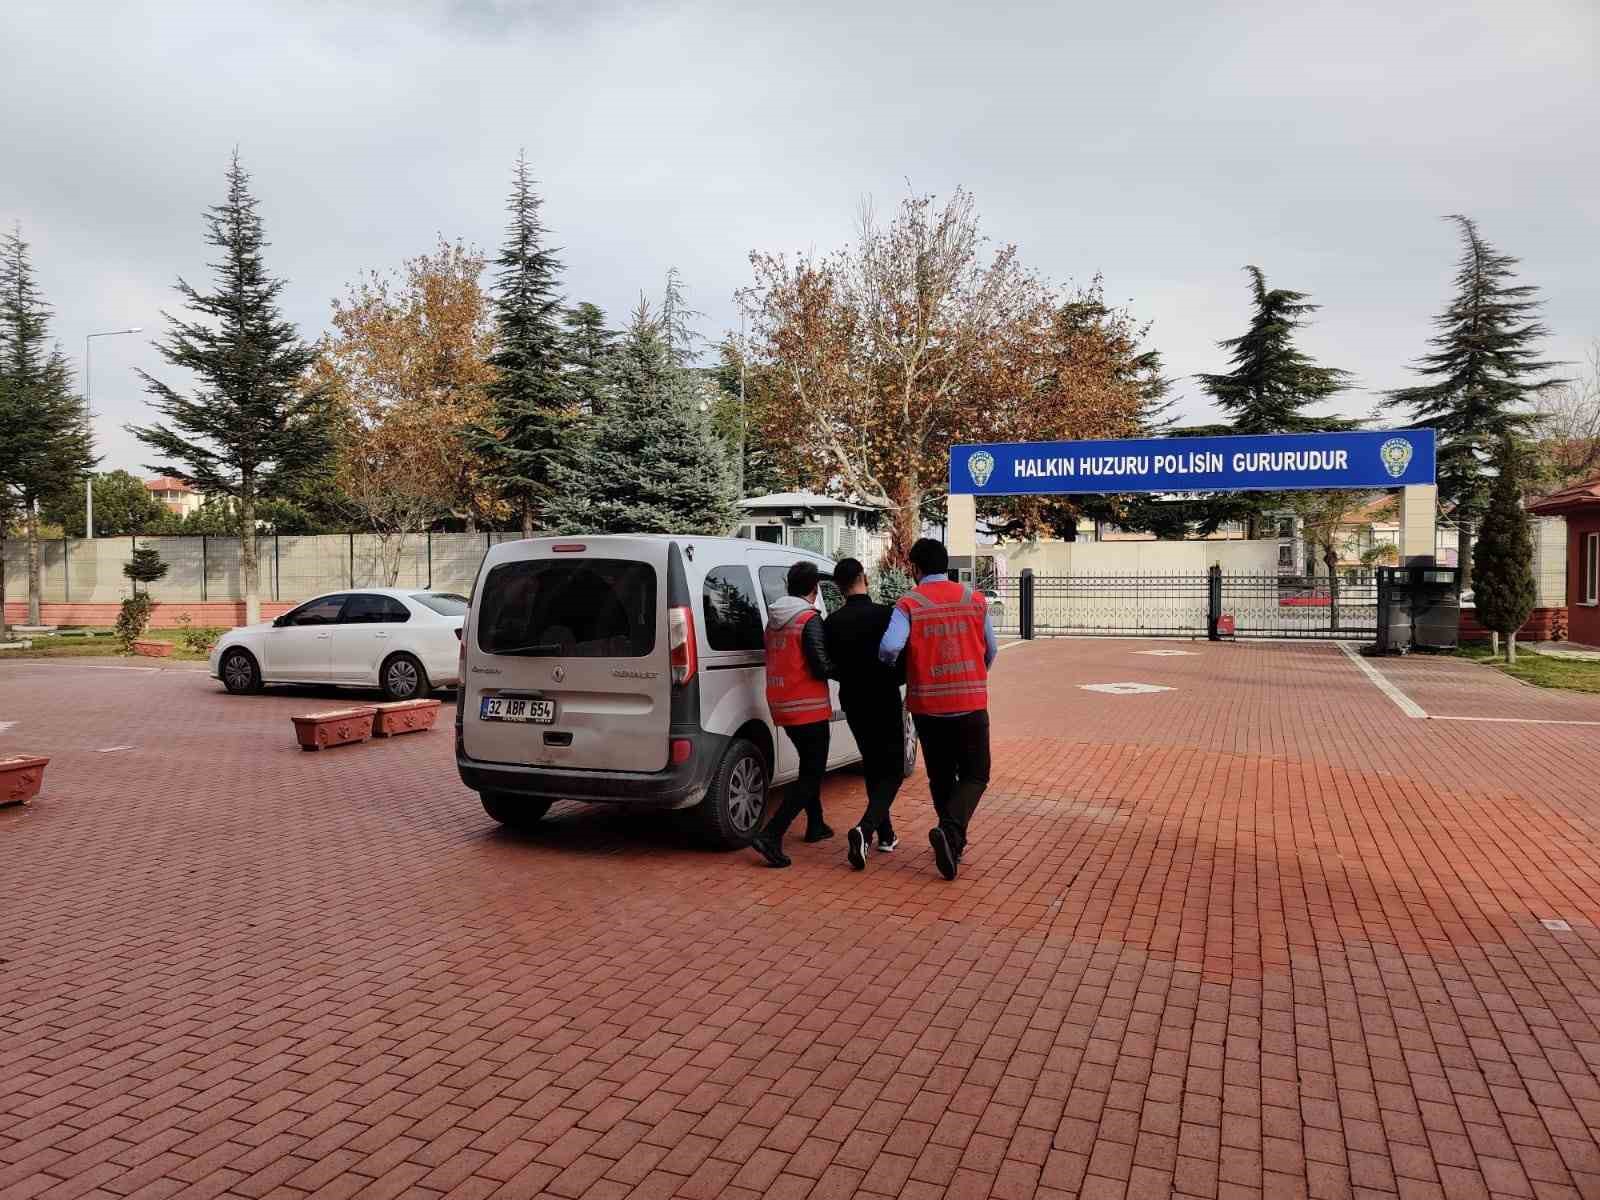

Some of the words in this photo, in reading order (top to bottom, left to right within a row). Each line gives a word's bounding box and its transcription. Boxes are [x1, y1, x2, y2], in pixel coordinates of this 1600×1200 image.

[1014, 456, 1075, 478] HALKIN
[1079, 454, 1150, 476] HUZURU
[1154, 451, 1224, 475] POLİSİN
[1232, 449, 1348, 473] GURURUDUR
[488, 700, 502, 715] 32
[506, 700, 526, 716] ABR
[530, 702, 551, 718] 654
